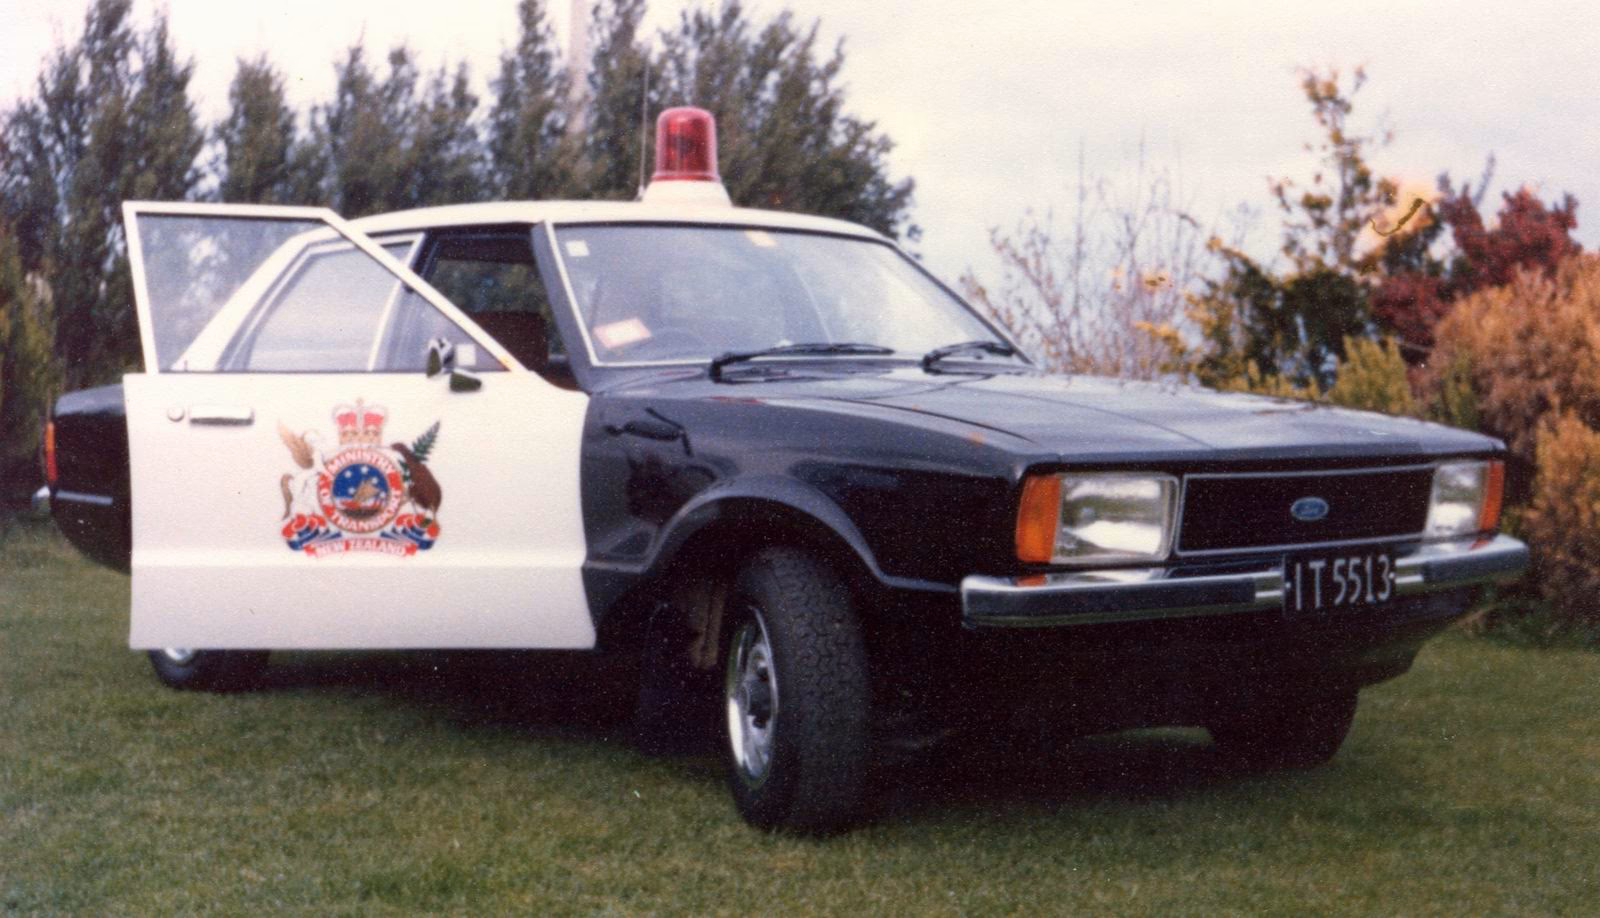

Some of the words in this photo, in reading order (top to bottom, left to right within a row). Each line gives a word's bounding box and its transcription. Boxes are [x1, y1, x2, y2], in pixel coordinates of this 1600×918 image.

[326, 448, 396, 475] MINISTRY
[331, 490, 403, 531] TRANSPORT
[316, 541, 344, 555] NEW
[350, 538, 404, 554] ZEALAND
